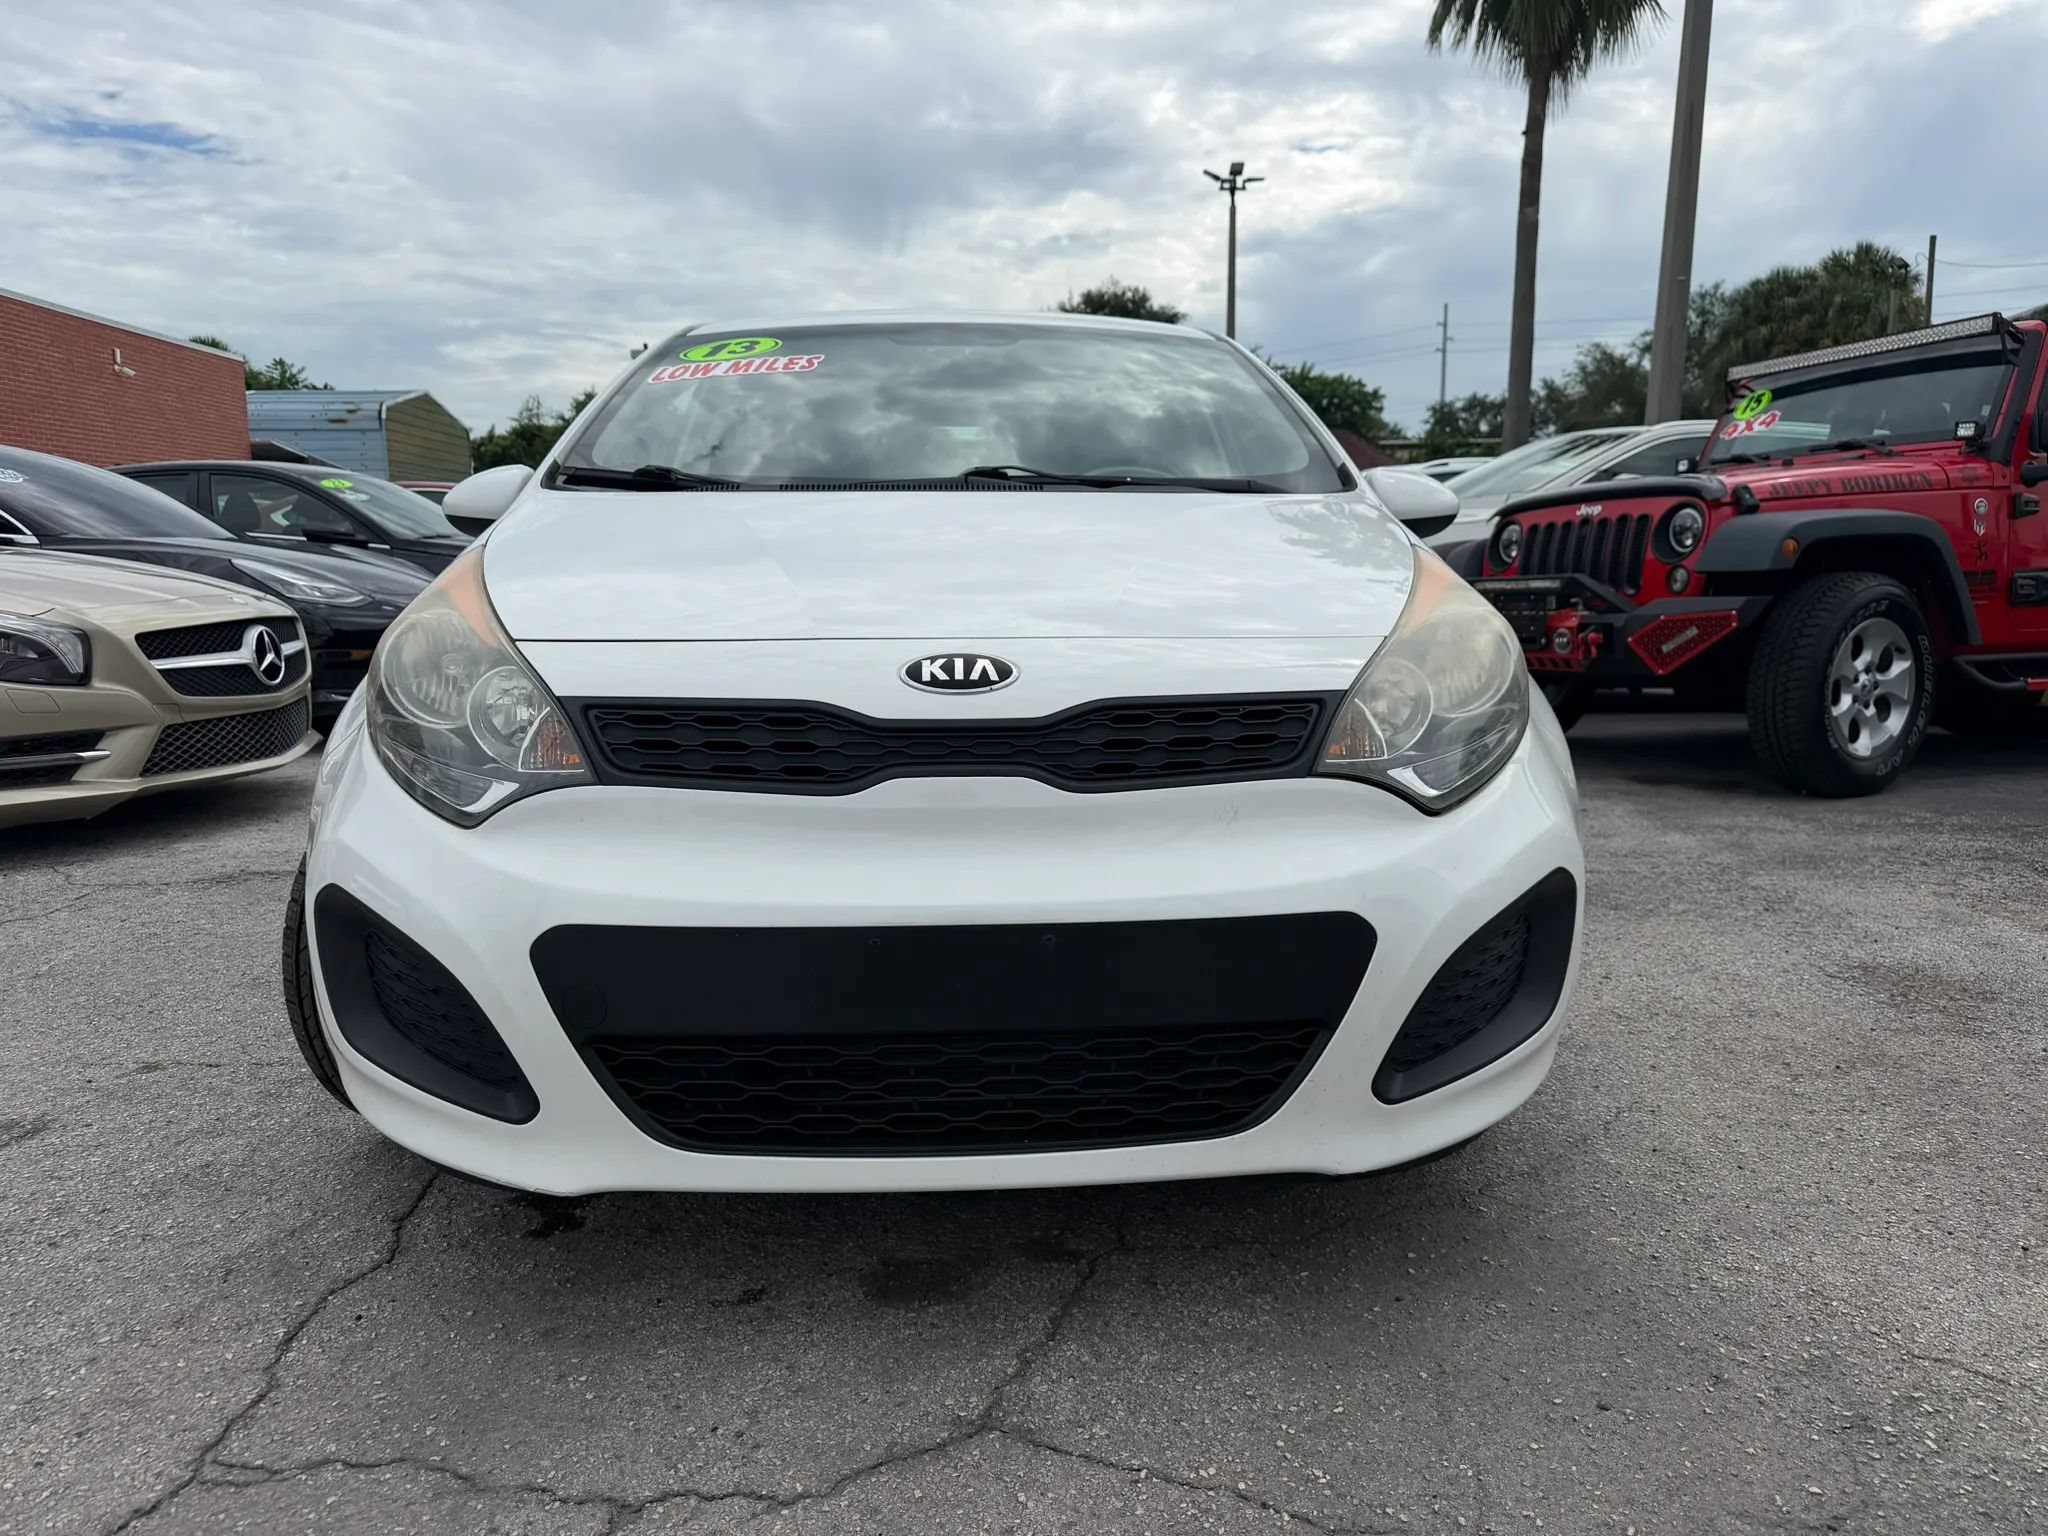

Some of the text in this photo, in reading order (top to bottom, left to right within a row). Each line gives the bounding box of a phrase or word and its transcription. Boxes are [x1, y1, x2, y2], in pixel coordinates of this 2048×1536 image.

[701, 340, 761, 359] 13
[651, 355, 823, 383] LOW MILES
[1576, 504, 1603, 517] Jeep
[920, 657, 1001, 682] KIA
